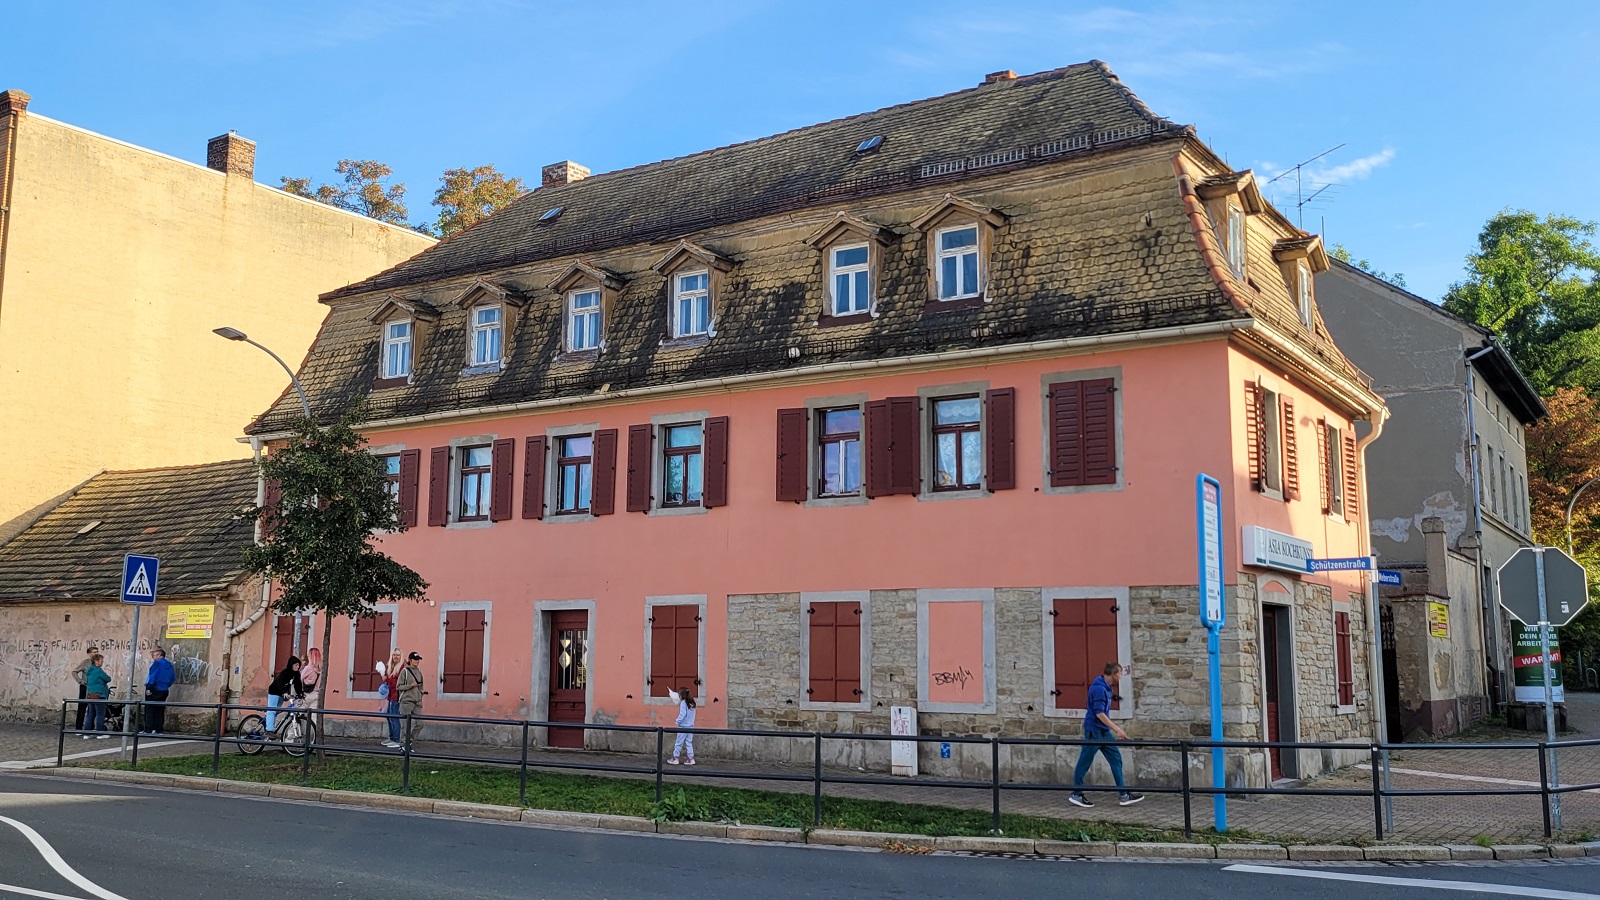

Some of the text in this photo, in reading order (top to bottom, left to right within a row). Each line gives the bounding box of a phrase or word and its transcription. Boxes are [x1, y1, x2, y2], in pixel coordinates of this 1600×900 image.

[1268, 538, 1313, 561] ASIA KOCHKUNST
[1310, 560, 1366, 570] Schützenstraße
[1521, 652, 1559, 665] WARM?
